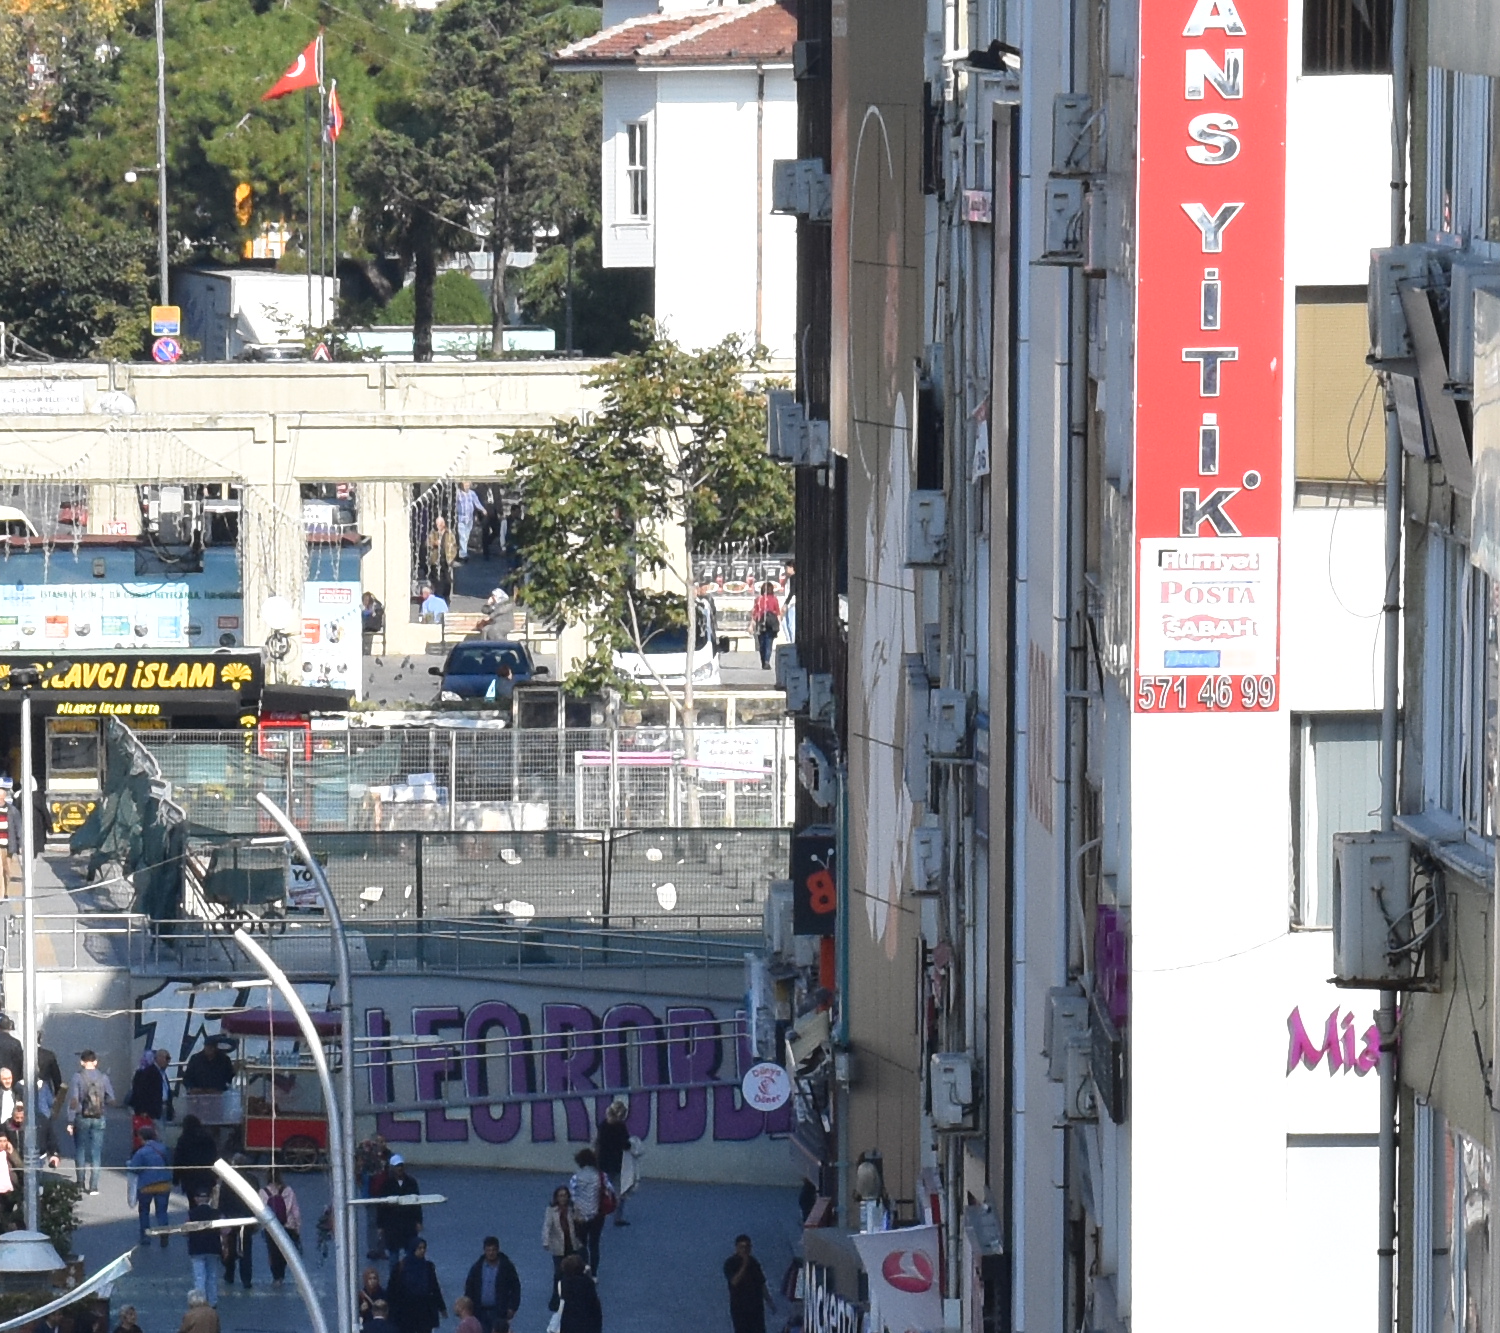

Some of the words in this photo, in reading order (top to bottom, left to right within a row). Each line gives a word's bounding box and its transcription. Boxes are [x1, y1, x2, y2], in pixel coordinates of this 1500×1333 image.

[1139, 677, 1188, 709] 571
[1197, 677, 1233, 709] 46
[1240, 677, 1276, 709] 99
